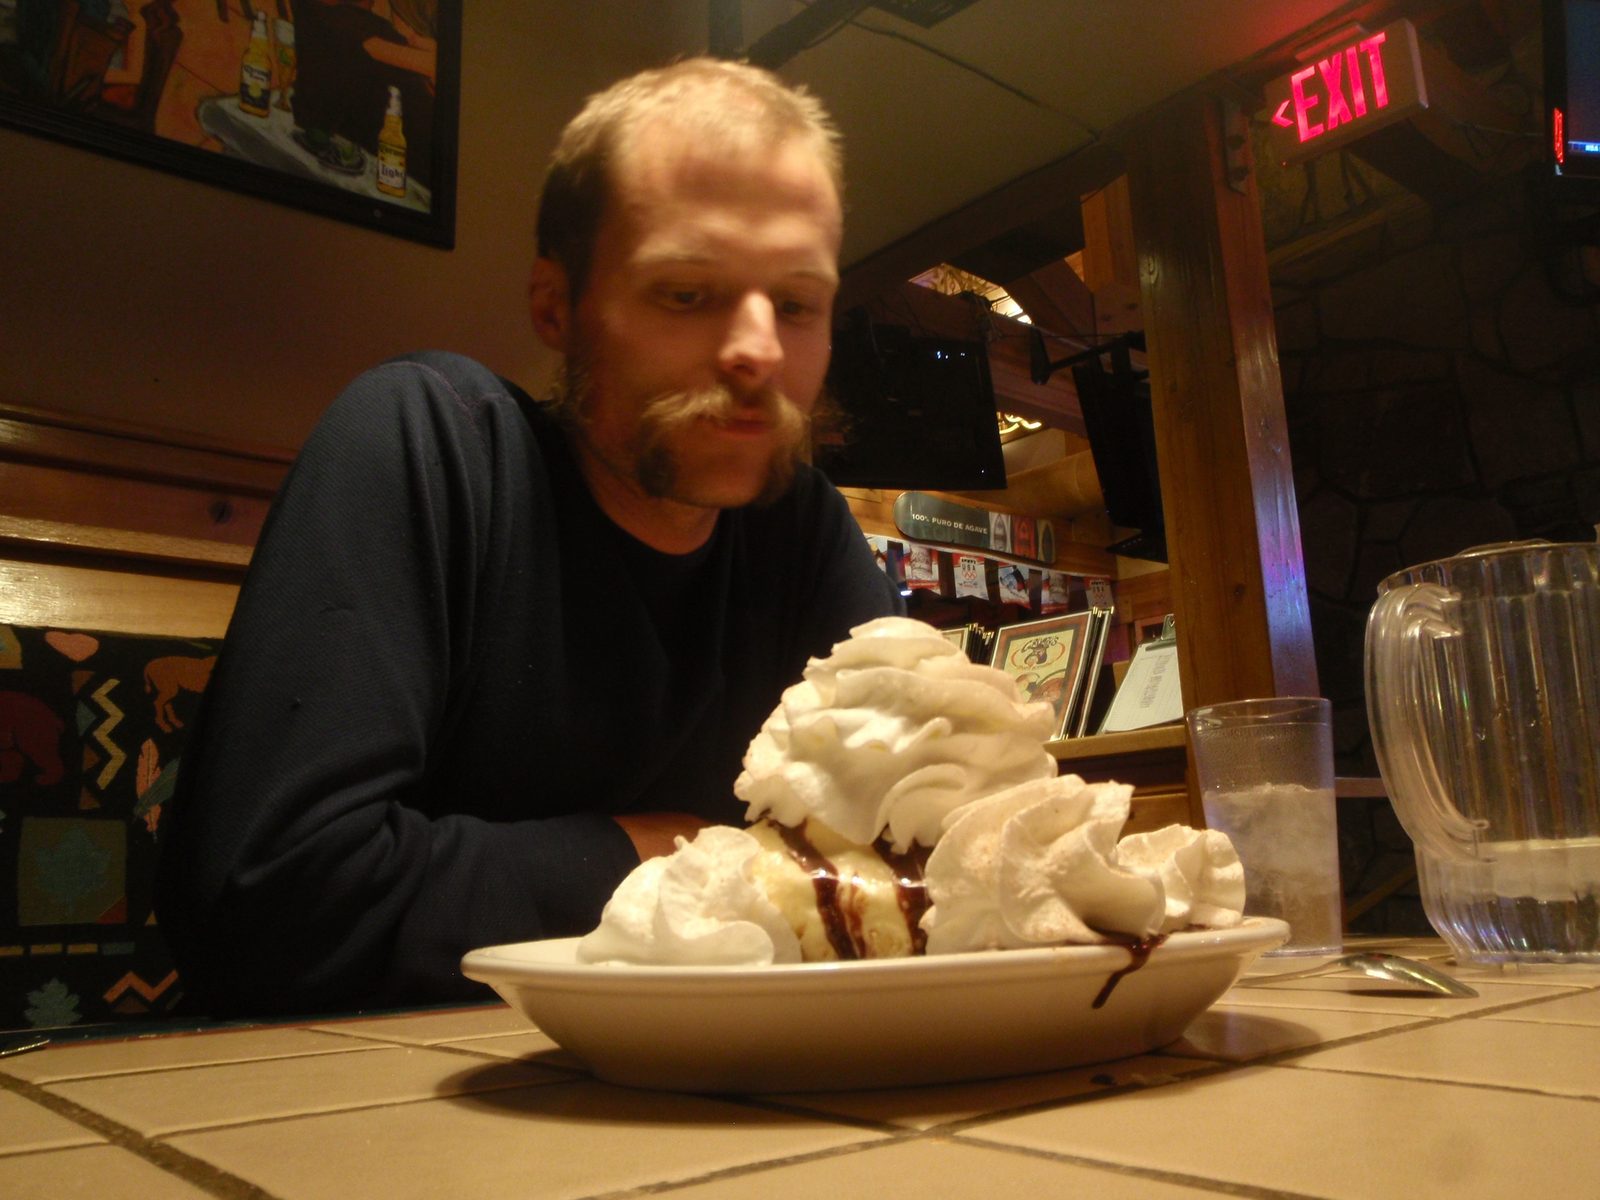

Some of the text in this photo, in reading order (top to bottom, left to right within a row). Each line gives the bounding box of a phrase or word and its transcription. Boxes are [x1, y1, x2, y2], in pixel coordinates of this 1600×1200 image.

[1291, 31, 1389, 143] EXIT
[911, 513, 988, 535] 100% PURO DE AGAVE
